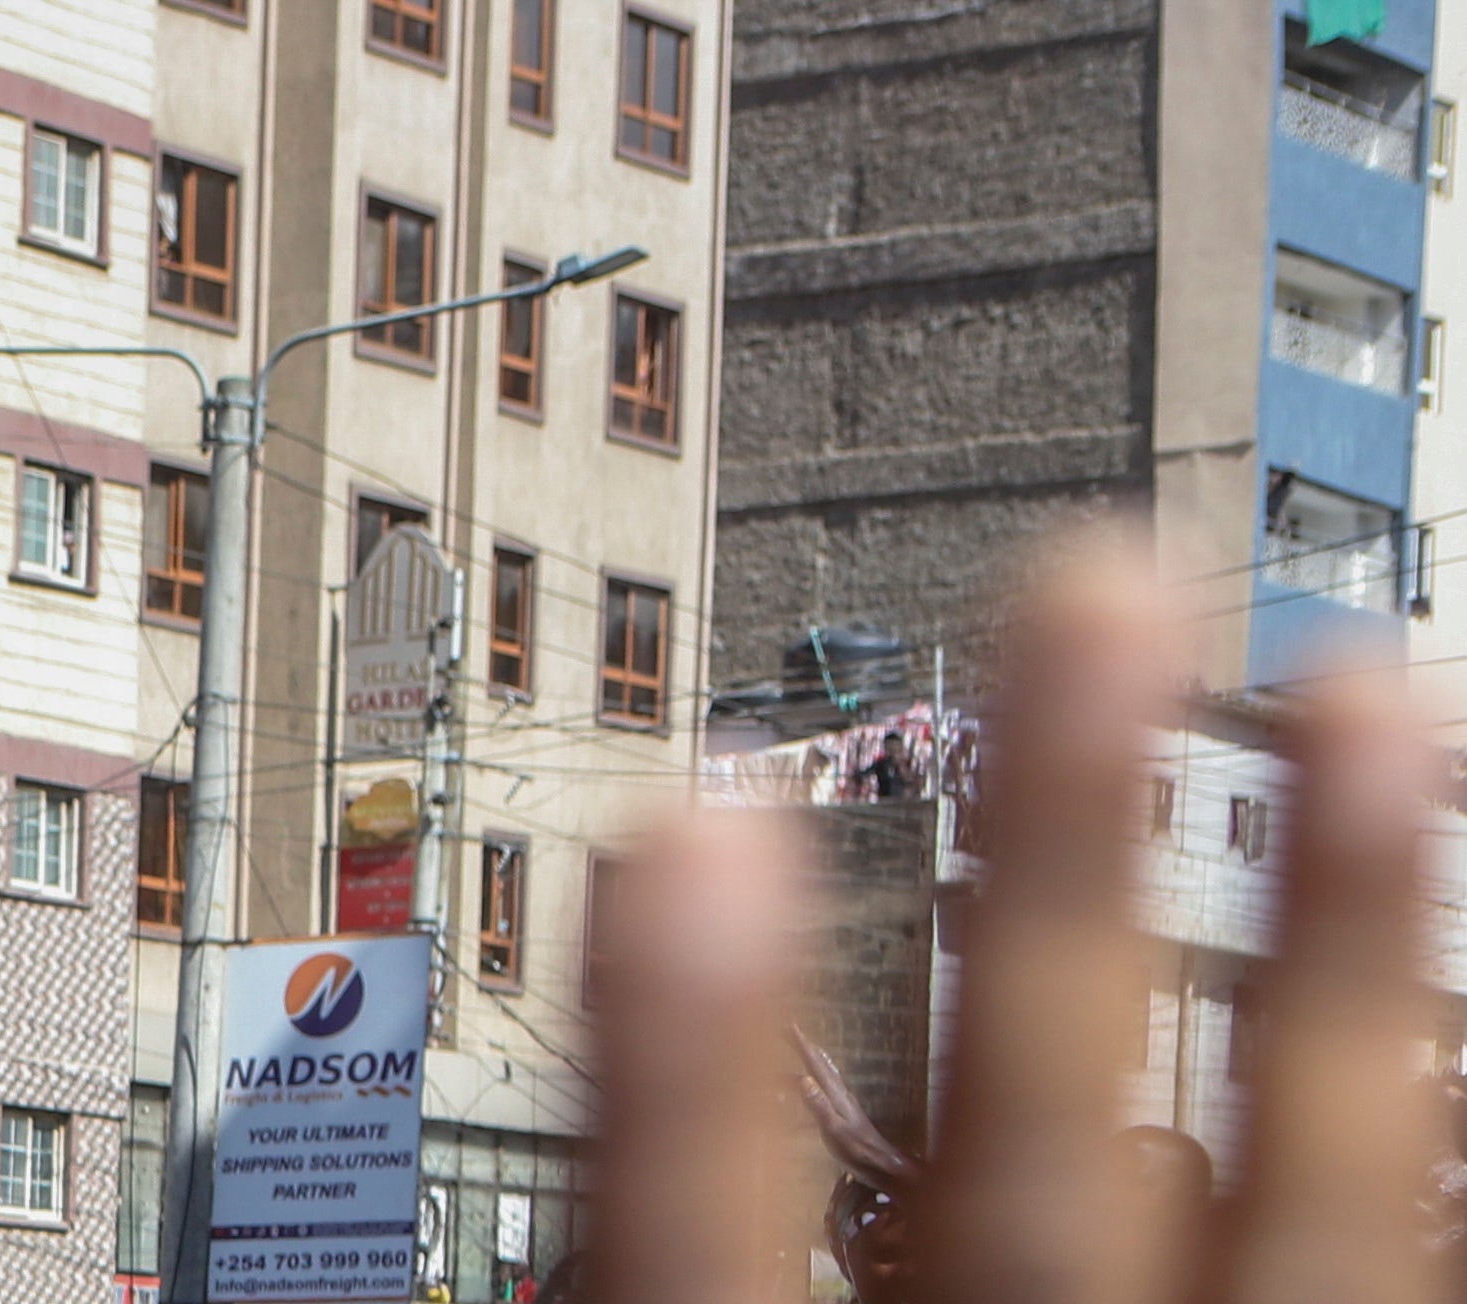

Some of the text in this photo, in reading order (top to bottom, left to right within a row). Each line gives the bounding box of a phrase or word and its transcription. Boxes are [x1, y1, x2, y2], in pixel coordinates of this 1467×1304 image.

[348, 686, 426, 715] GARDE
[226, 1051, 417, 1088] NADSOM
[225, 1091, 269, 1107] Freight
[288, 1091, 343, 1105] Logistics
[248, 1123, 390, 1144] YOUR ULTIMATE
[221, 1151, 413, 1174] SHIPPING SOLUTIONS
[272, 1182, 357, 1200] PARTNER
[215, 1251, 407, 1271] +254 703 999 960
